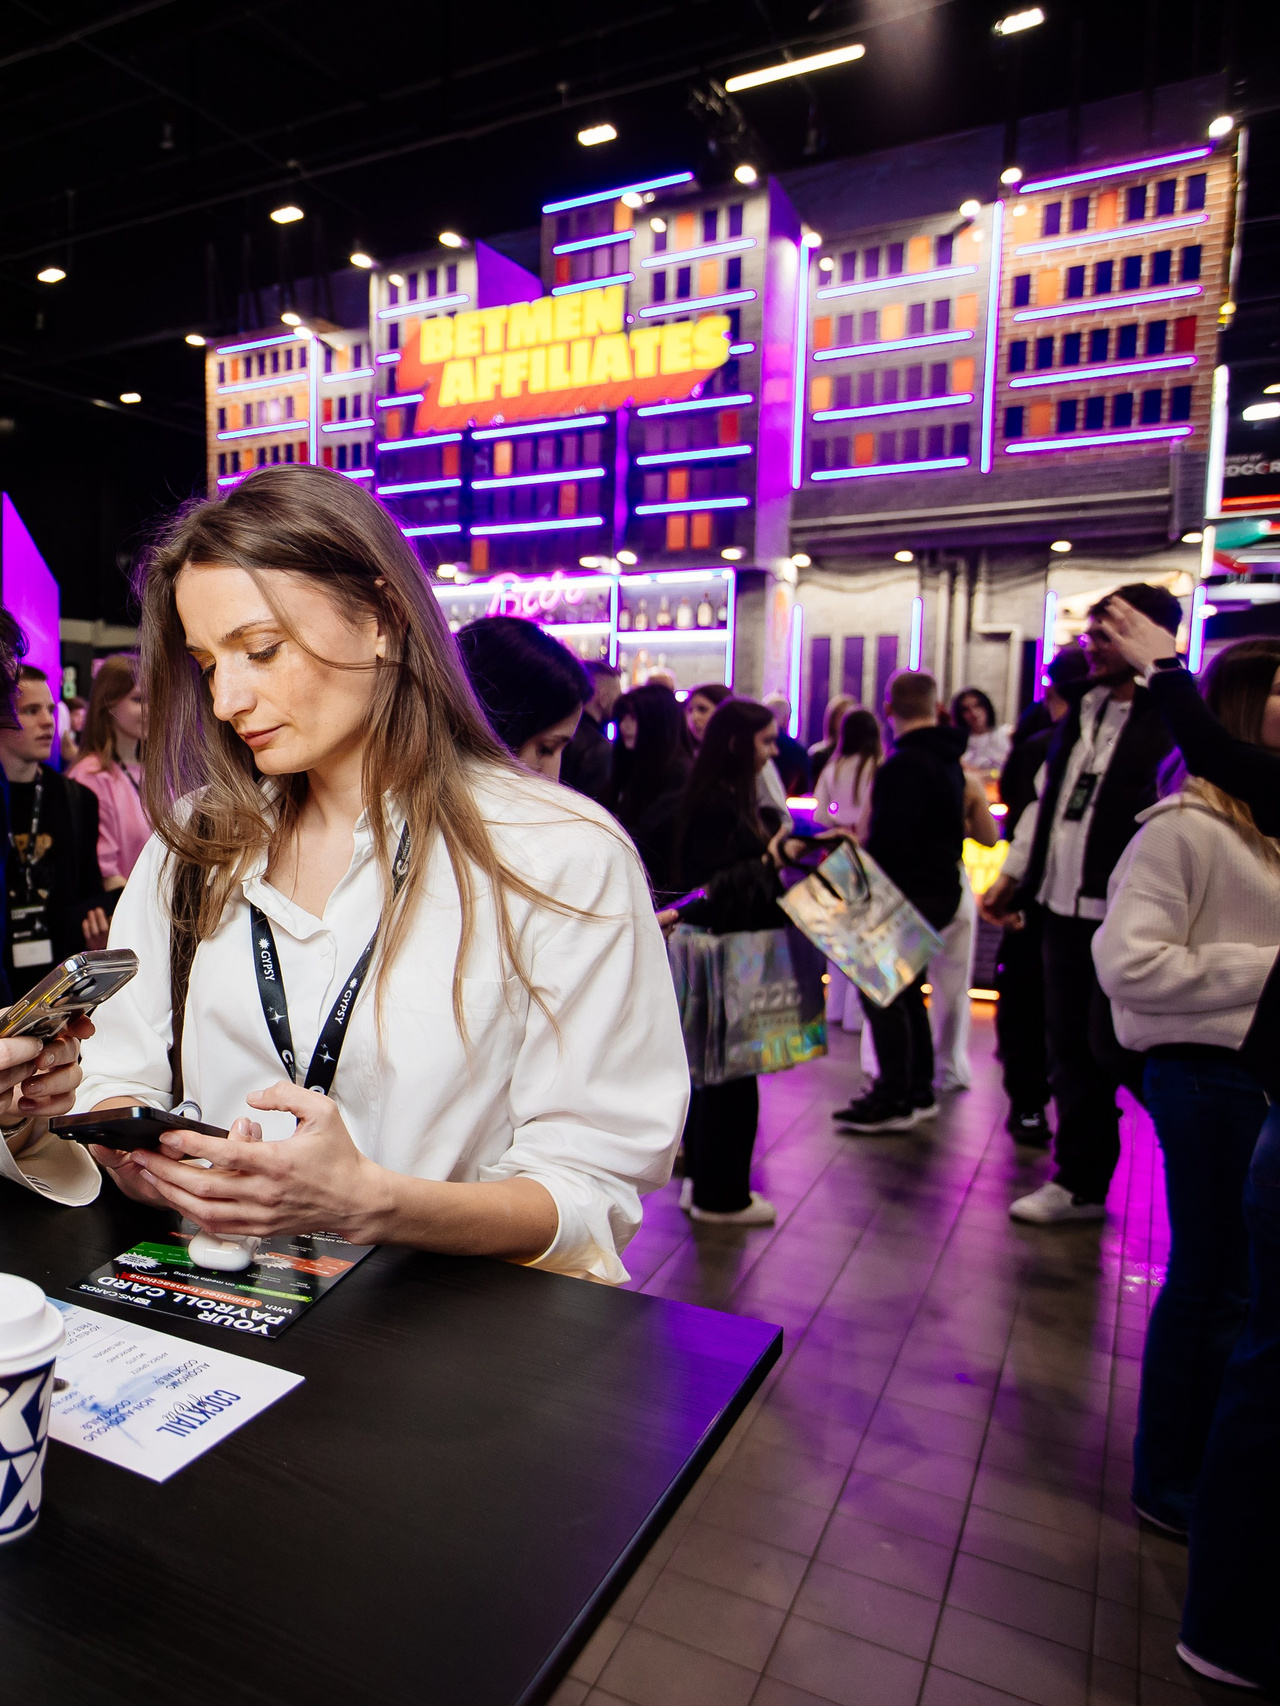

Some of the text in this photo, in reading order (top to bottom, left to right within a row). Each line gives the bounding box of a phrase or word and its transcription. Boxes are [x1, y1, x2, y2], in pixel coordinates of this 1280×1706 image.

[419, 284, 626, 365] BETMEN
[437, 313, 732, 408] AFFILIATES
[259, 949, 276, 981] GYPSY
[334, 989, 354, 1025] GYPSY
[128, 1273, 198, 1295] transactions
[173, 1270, 200, 1281] buying
[96, 1275, 287, 1327] PAYROLL CARD
[200, 1289, 258, 1307] Unlimited
[196, 1309, 270, 1335] YOUR
[83, 1396, 156, 1442] NON-ALCOHOLIC
[155, 1389, 241, 1438] COCKTAIL
